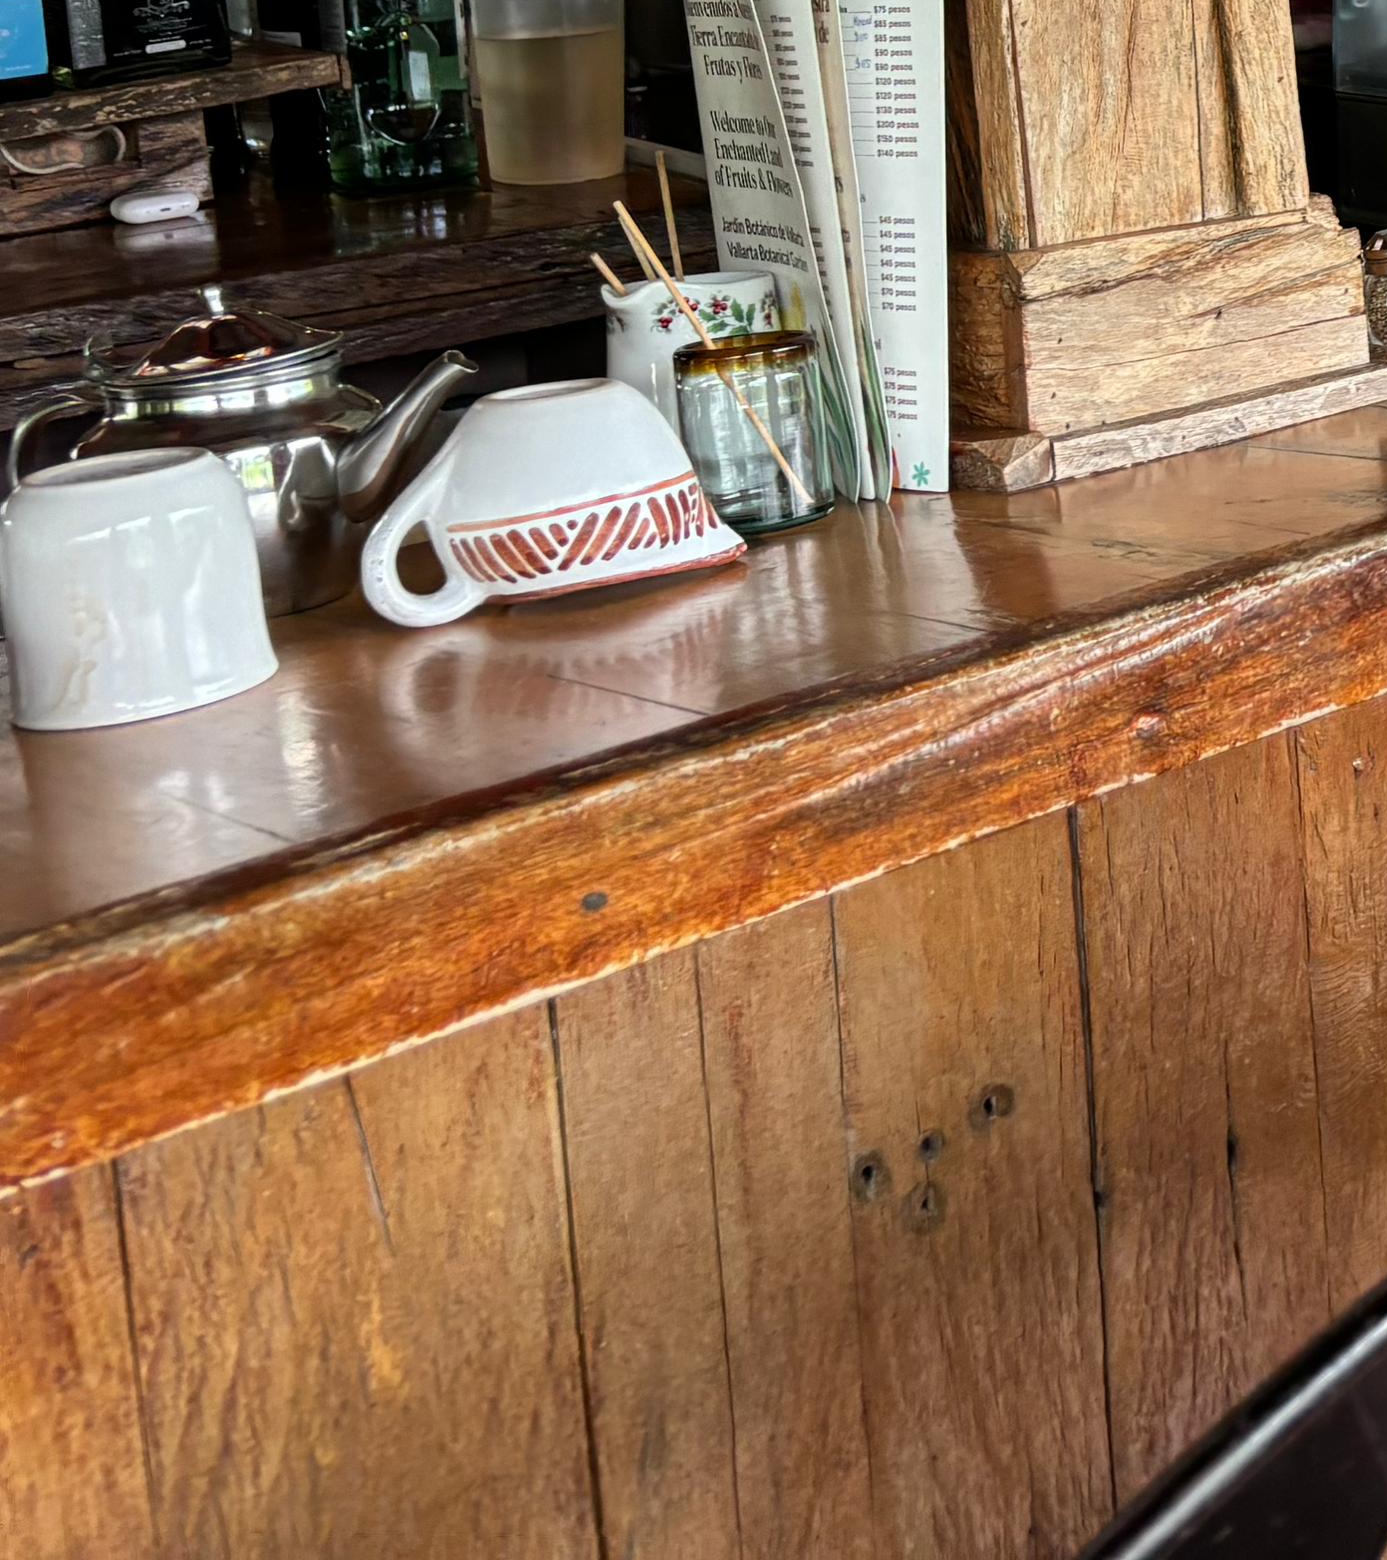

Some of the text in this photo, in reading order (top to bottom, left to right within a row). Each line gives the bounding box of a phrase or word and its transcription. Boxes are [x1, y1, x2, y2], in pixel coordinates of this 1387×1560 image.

[690, 25, 718, 47] Tierra
[704, 55, 736, 76] Frutas
[710, 110, 755, 135] Welcome
[714, 138, 766, 163] Enchanted
[714, 164, 725, 186] of
[725, 166, 757, 190] Fruits
[758, 168, 767, 191] &
[726, 241, 759, 261] Vallarta
